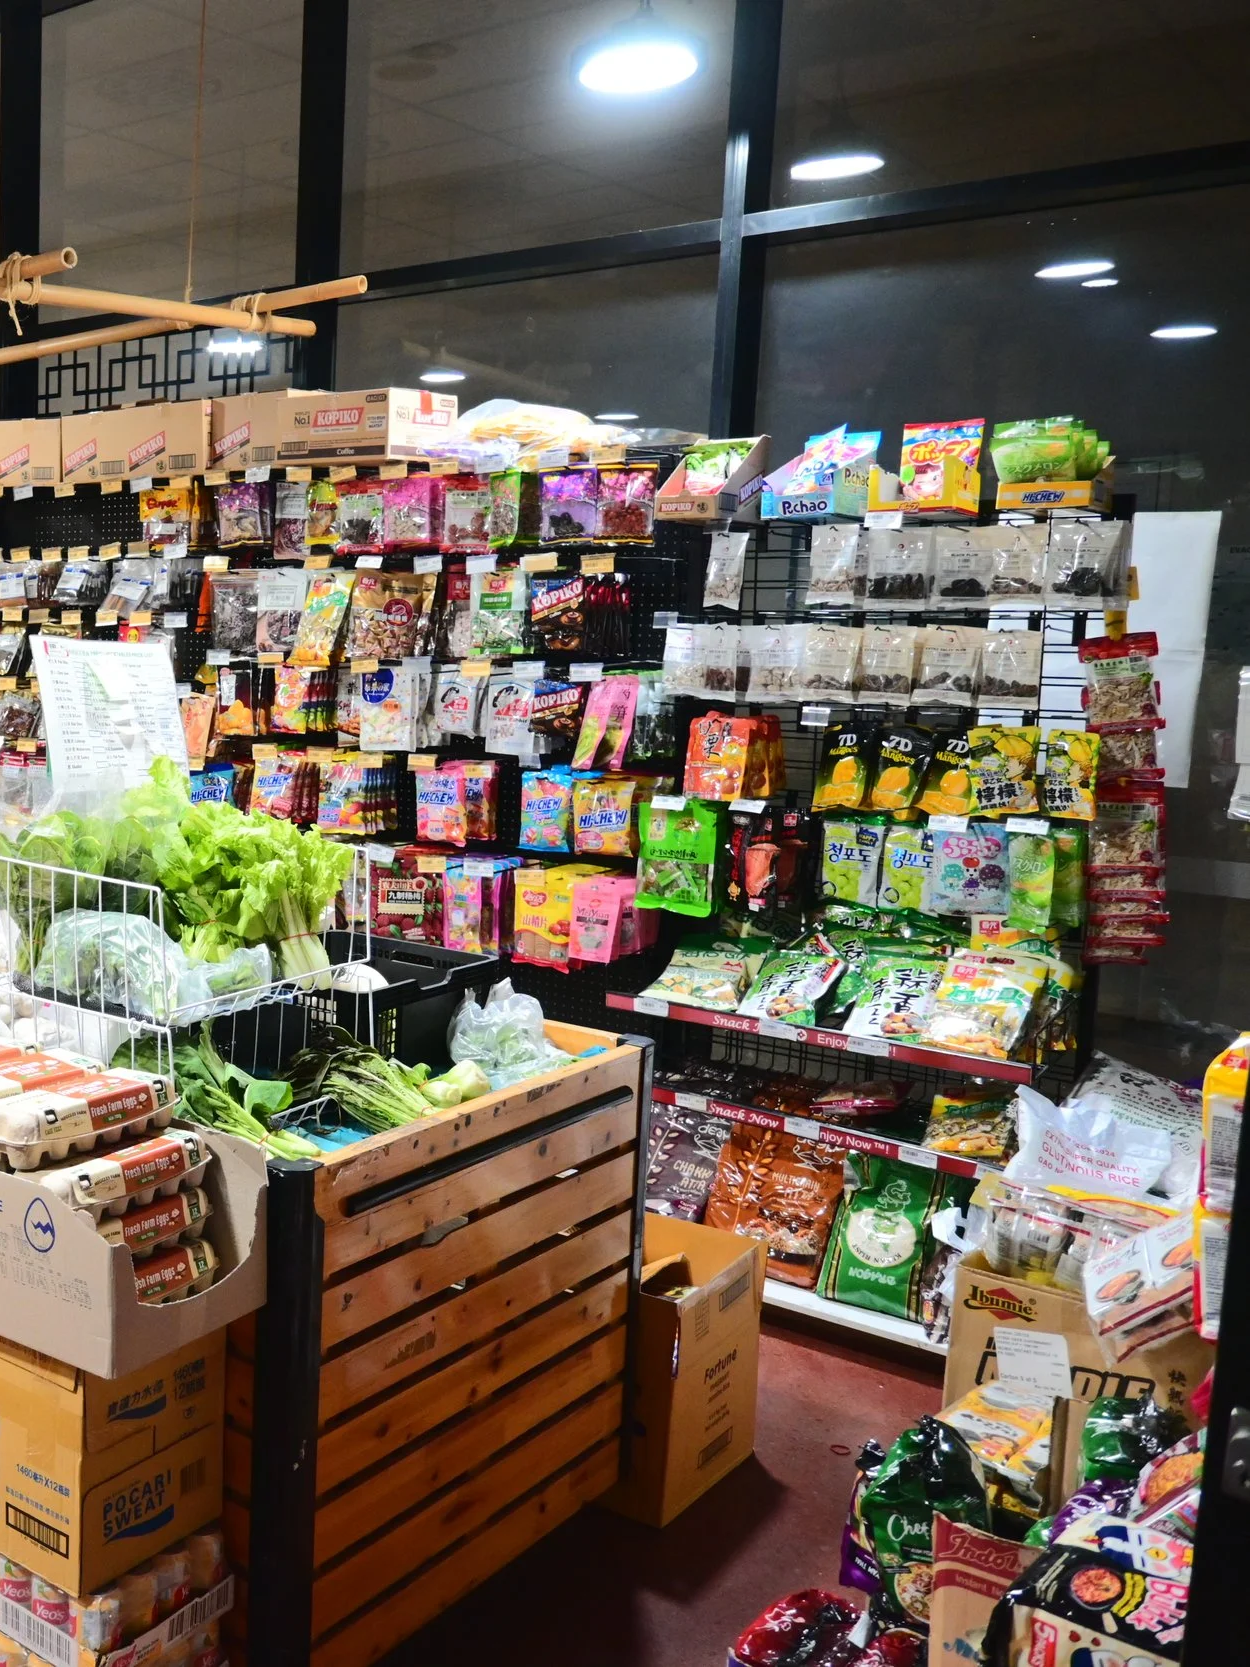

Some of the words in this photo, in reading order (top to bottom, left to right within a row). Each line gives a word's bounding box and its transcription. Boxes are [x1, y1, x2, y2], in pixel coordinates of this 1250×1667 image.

[317, 408, 361, 426] KOPIKO
[215, 425, 249, 454] KOPIKO
[0, 447, 28, 471] KOPIKO
[65, 441, 96, 471] KOPIKO
[130, 435, 164, 464] KOPIKO
[337, 448, 355, 456] Coffee
[1022, 491, 1065, 503] HI-CHEW
[660, 503, 692, 512] KOPIKO
[533, 577, 583, 613] KOPIKO
[533, 689, 580, 708] KOPIKO
[839, 734, 857, 746] 7D
[890, 735, 913, 751] 7D
[948, 739, 969, 752] 7D
[257, 773, 291, 787] HI-CHEW
[418, 790, 456, 804] HI-CHEW
[526, 797, 561, 811] HI-CHEW
[579, 810, 627, 828] HI-CHEW
[829, 843, 871, 864] 청포도
[711, 1014, 750, 1032] Snack
[817, 1033, 848, 1050] Enjoy
[91, 1102, 107, 1118] Fresh
[108, 1098, 123, 1112] Farm
[123, 1096, 137, 1111] Eggs
[708, 1103, 746, 1121] Snack
[748, 1112, 779, 1128] Now
[819, 1130, 844, 1147] njoy
[845, 1134, 870, 1151] Now
[125, 1165, 141, 1180] Fresh
[141, 1161, 156, 1174] Farm
[156, 1156, 170, 1171] Eggs
[1042, 1142, 1104, 1180] GLUTINOUS
[1109, 1173, 1140, 1188] RICE
[1096, 1159, 1139, 1174] QUALITY
[680, 1176, 706, 1190] ATTA
[125, 1221, 141, 1236] Fresh
[141, 1217, 156, 1231] Farm
[156, 1213, 170, 1227] Eggs
[147, 1272, 161, 1286] Farm
[161, 1267, 176, 1281] Eggs
[848, 1266, 896, 1286] DRAGON
[967, 1284, 1033, 1316] Ibumie
[704, 1348, 737, 1384] Fortune
[103, 1470, 172, 1521] POCARI
[103, 1489, 166, 1538] SWEAT
[3, 1583, 31, 1597] Yeo's
[36, 1603, 65, 1620] Yeo's
